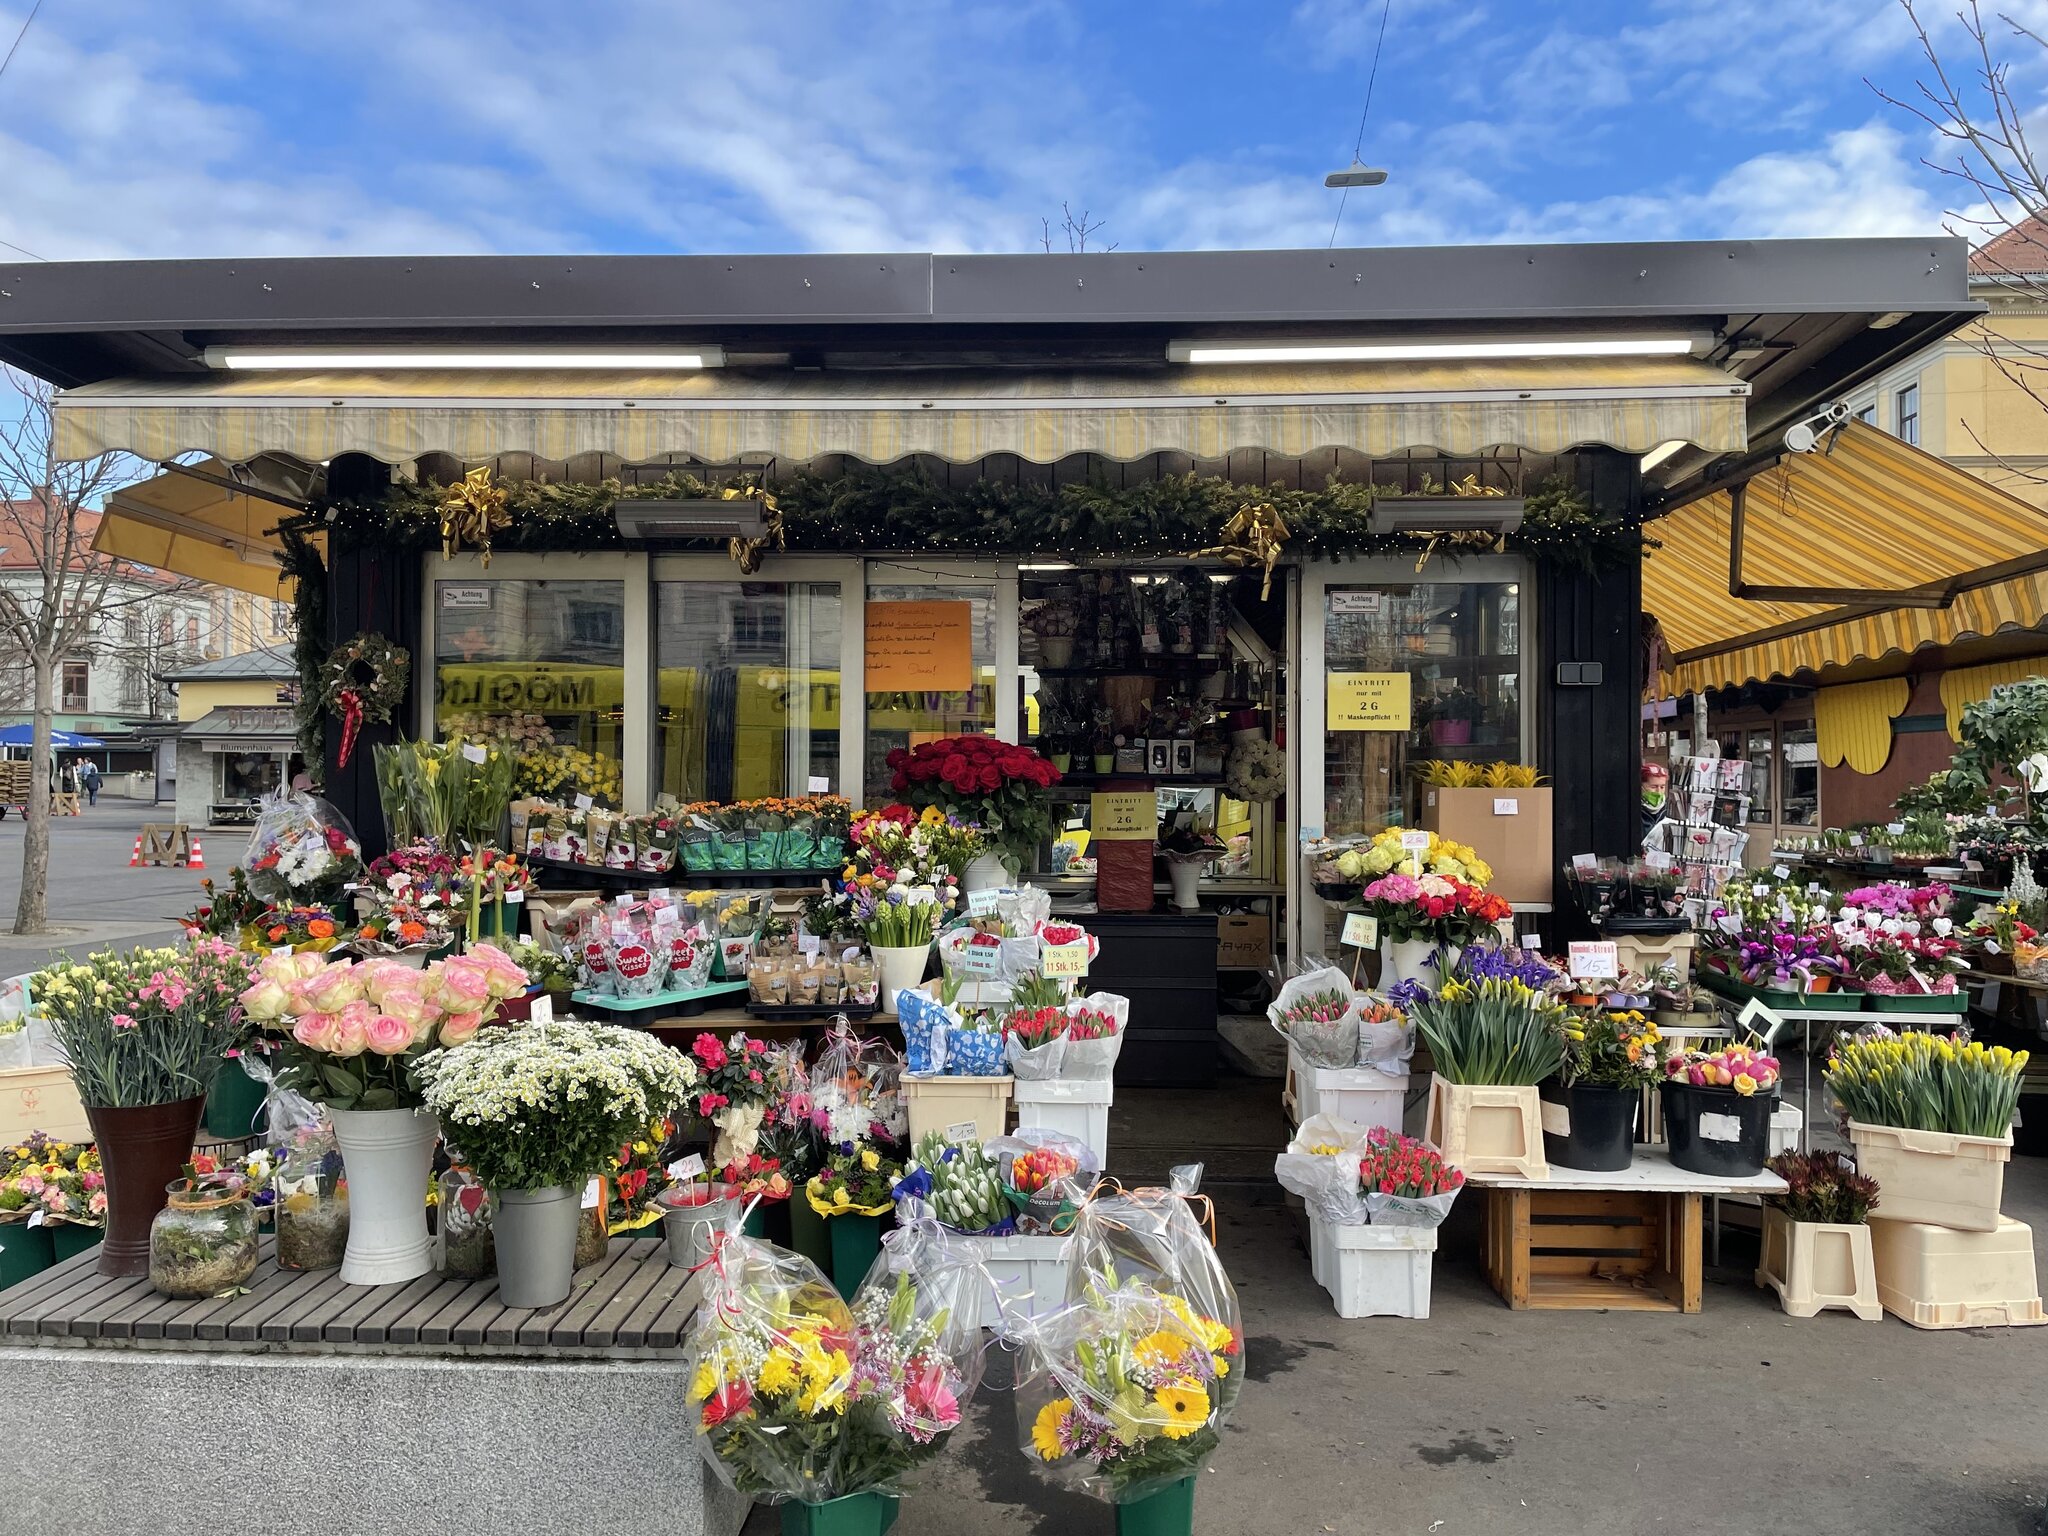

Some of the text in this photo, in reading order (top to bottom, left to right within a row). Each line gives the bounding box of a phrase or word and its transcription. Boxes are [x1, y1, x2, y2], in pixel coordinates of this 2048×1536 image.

[462, 591, 482, 599] Achtung
[1350, 595, 1372, 603] Achtung
[220, 744, 272, 752] Blumenhaus
[1052, 950, 1062, 958] Stk.
[1067, 950, 1078, 958] 1,50
[616, 952, 649, 966] Sweet
[622, 962, 648, 971] Kisses
[1046, 962, 1055, 972] 11
[1056, 962, 1068, 972] Stk.
